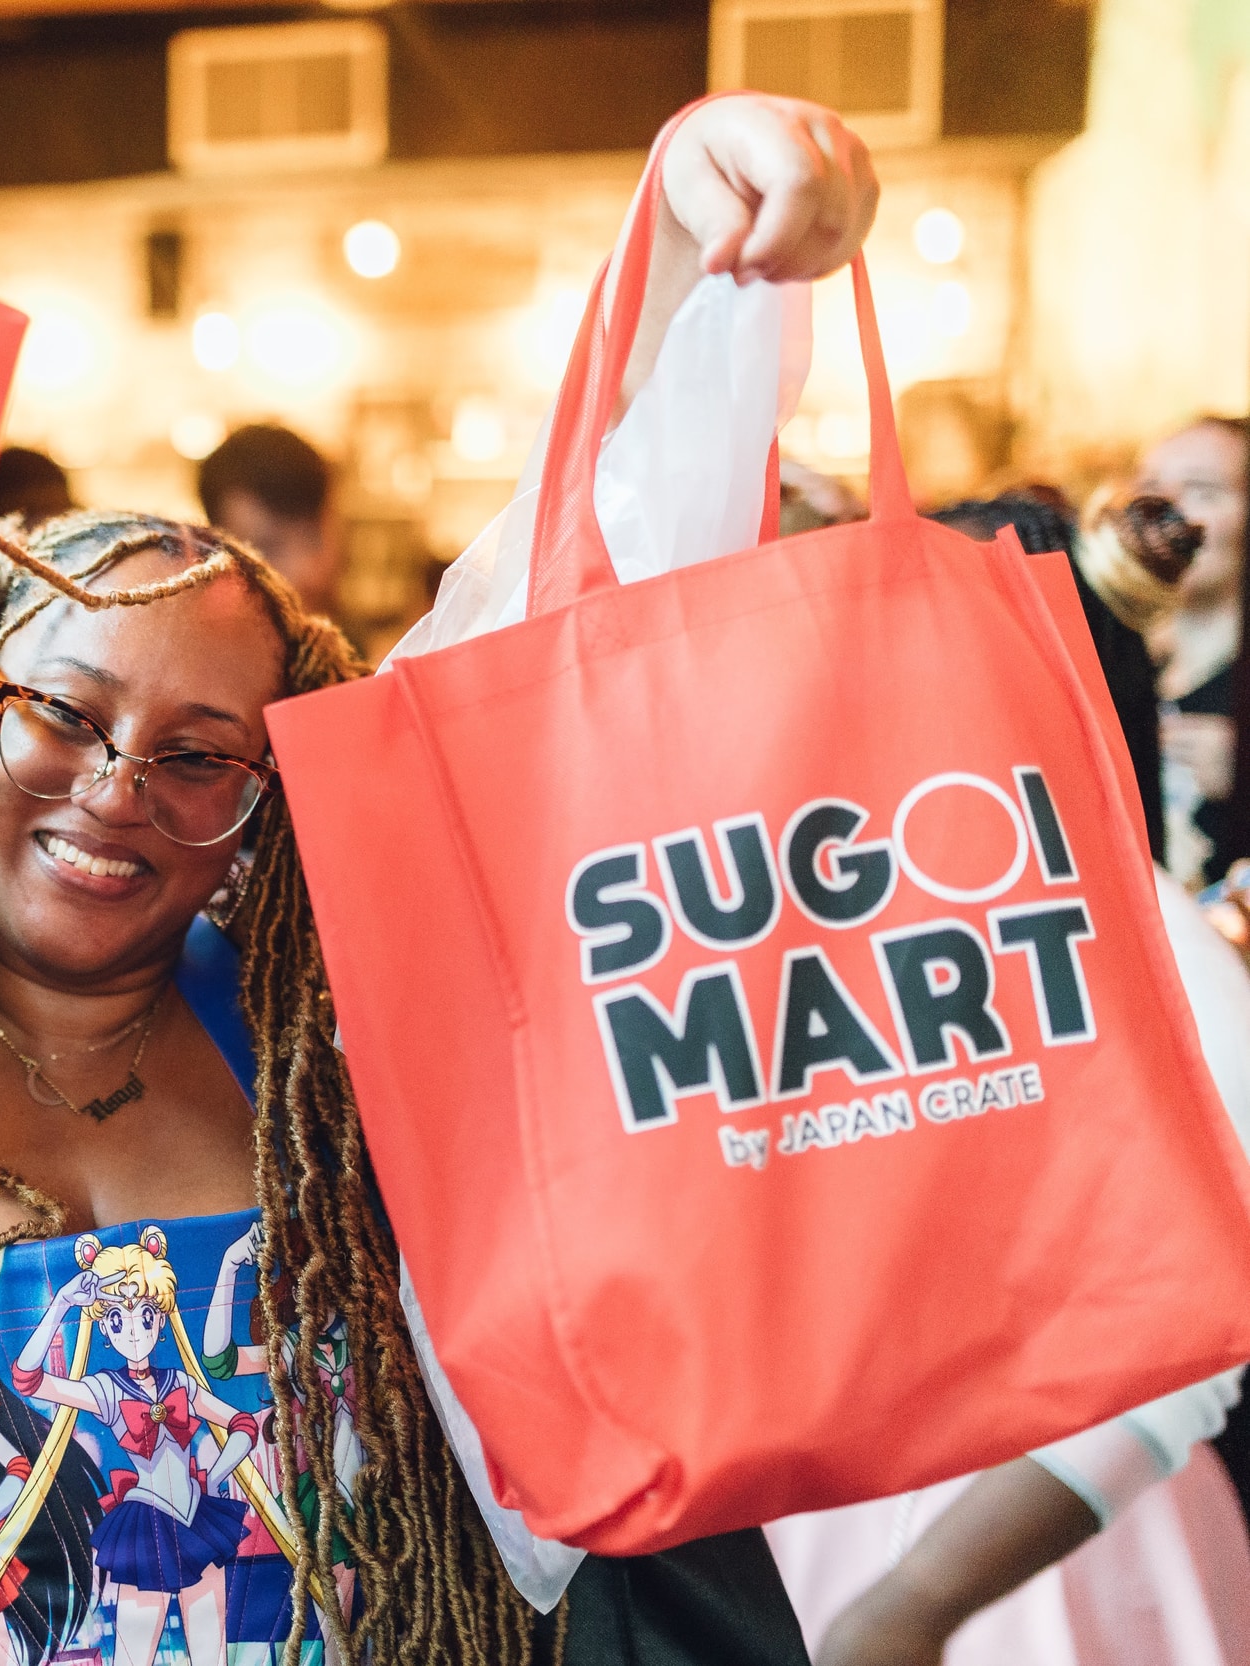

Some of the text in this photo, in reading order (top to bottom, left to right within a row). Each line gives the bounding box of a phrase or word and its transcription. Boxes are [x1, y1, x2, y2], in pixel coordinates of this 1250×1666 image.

[565, 765, 1079, 984] SUGOI
[592, 898, 1096, 1133] MART
[718, 1062, 1044, 1169] by JAPAN CRATE
